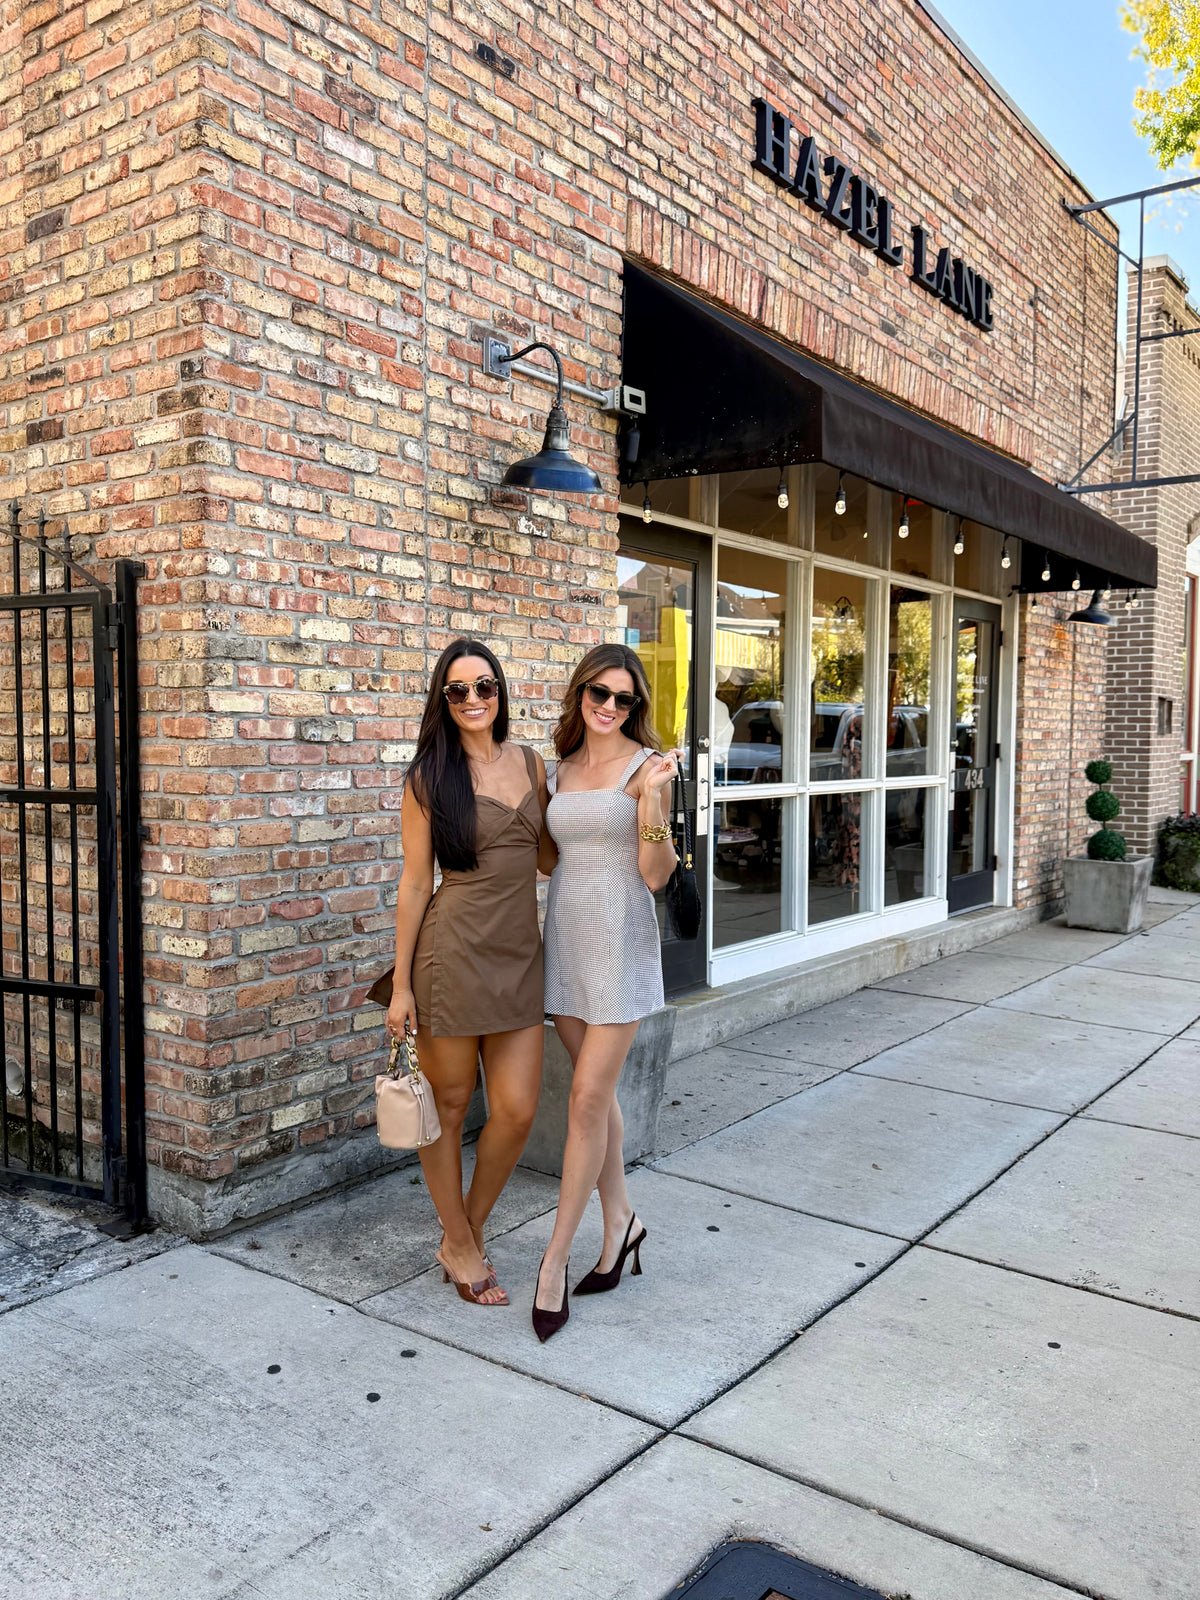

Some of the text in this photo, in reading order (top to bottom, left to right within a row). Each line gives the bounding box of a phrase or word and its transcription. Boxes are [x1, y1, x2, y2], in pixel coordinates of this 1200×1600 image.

[751, 97, 994, 333] HAZEL LANE
[964, 768, 984, 790] 434
